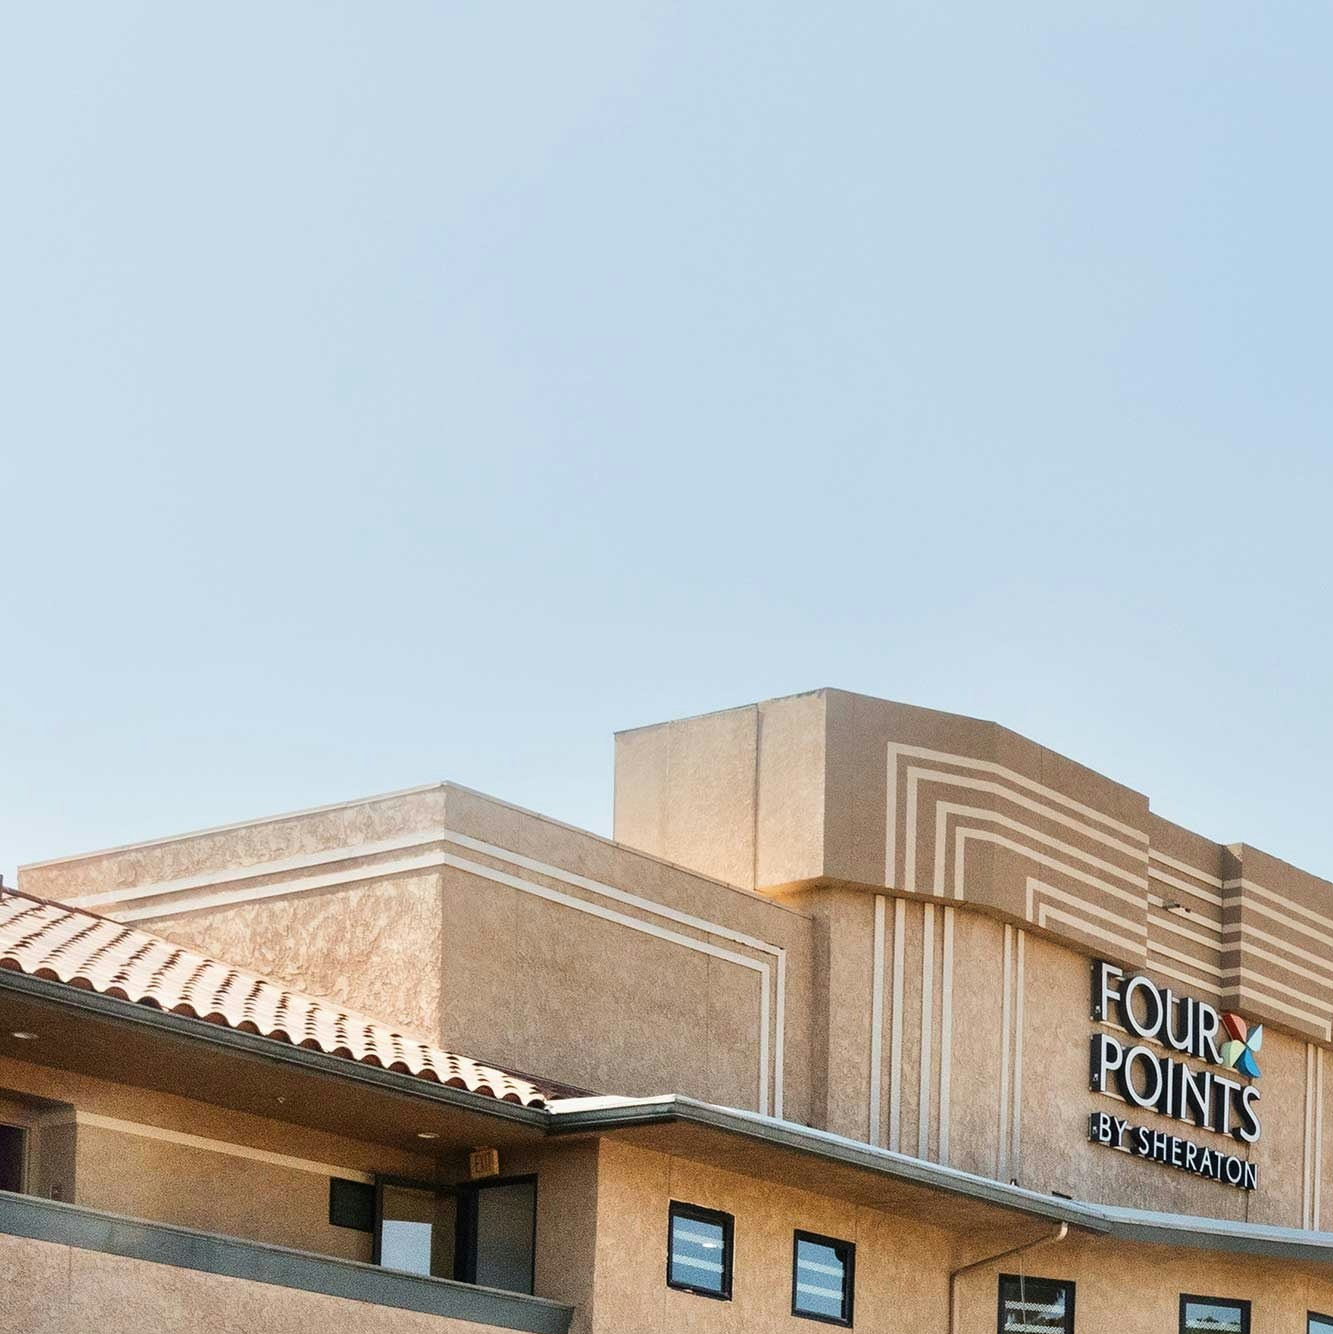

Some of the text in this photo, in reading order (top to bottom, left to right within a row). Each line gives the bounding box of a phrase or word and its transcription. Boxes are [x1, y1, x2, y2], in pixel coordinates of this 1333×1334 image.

[1099, 961, 1224, 1065] FOUR
[1099, 1033, 1262, 1143] POINTS
[1098, 1112, 1259, 1190] BY SHERATON
